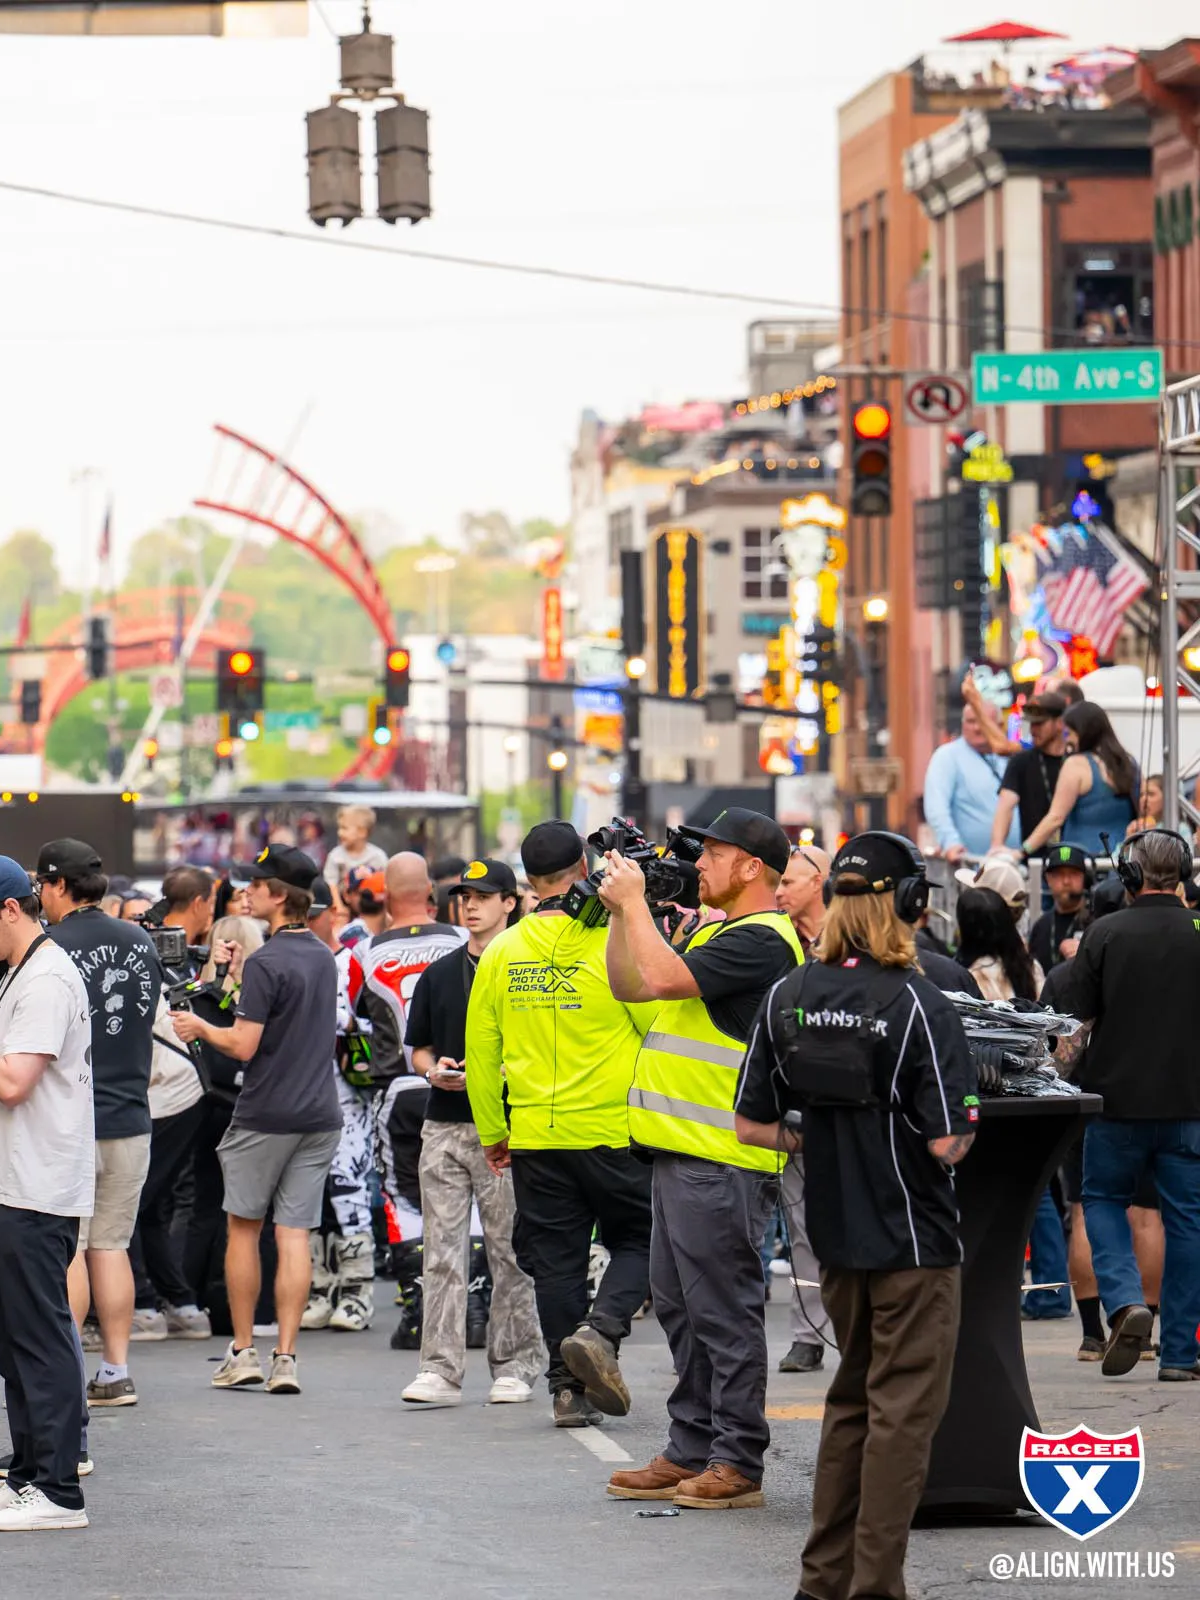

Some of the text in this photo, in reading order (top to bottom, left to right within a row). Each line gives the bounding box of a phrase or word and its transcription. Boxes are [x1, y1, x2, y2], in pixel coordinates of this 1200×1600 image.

[982, 360, 1155, 392] N-4th Ave-S
[507, 968, 547, 976] SUPER
[511, 976, 545, 984] MOTO
[123, 951, 152, 1017] REPEAT
[508, 984, 546, 993] CROSS
[806, 1007, 888, 1037] MONSTR
